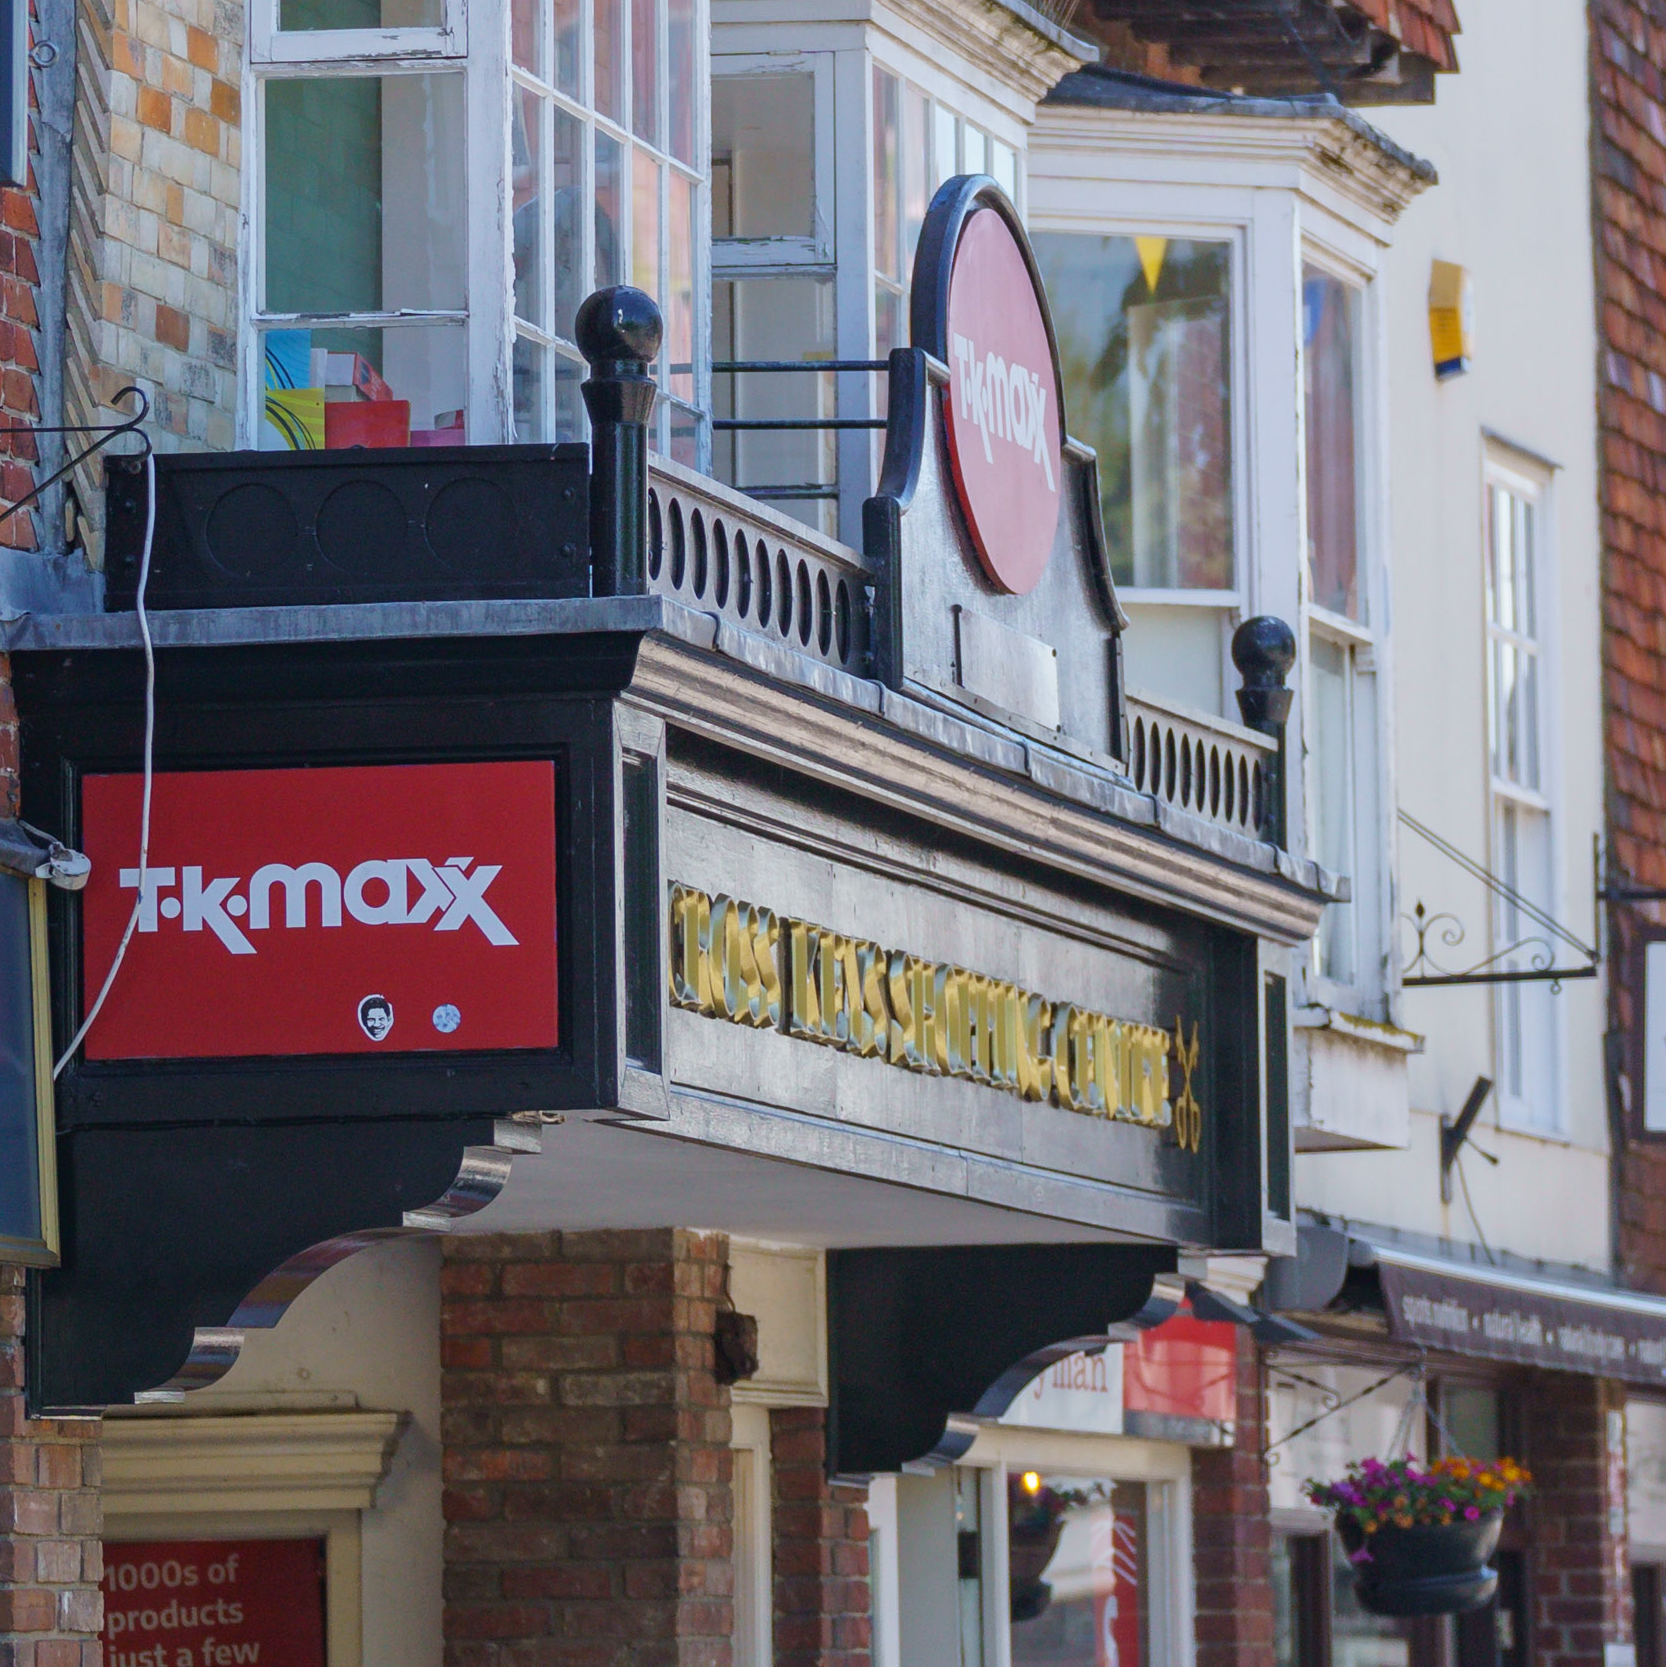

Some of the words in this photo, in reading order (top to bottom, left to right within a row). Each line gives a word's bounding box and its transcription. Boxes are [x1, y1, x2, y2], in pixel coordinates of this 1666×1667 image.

[105, 1560, 200, 1592] 1000s
[207, 1553, 240, 1585] of
[107, 1598, 245, 1641] products
[109, 1642, 168, 1667] just
[177, 1647, 195, 1667] a
[201, 1637, 261, 1667] few
